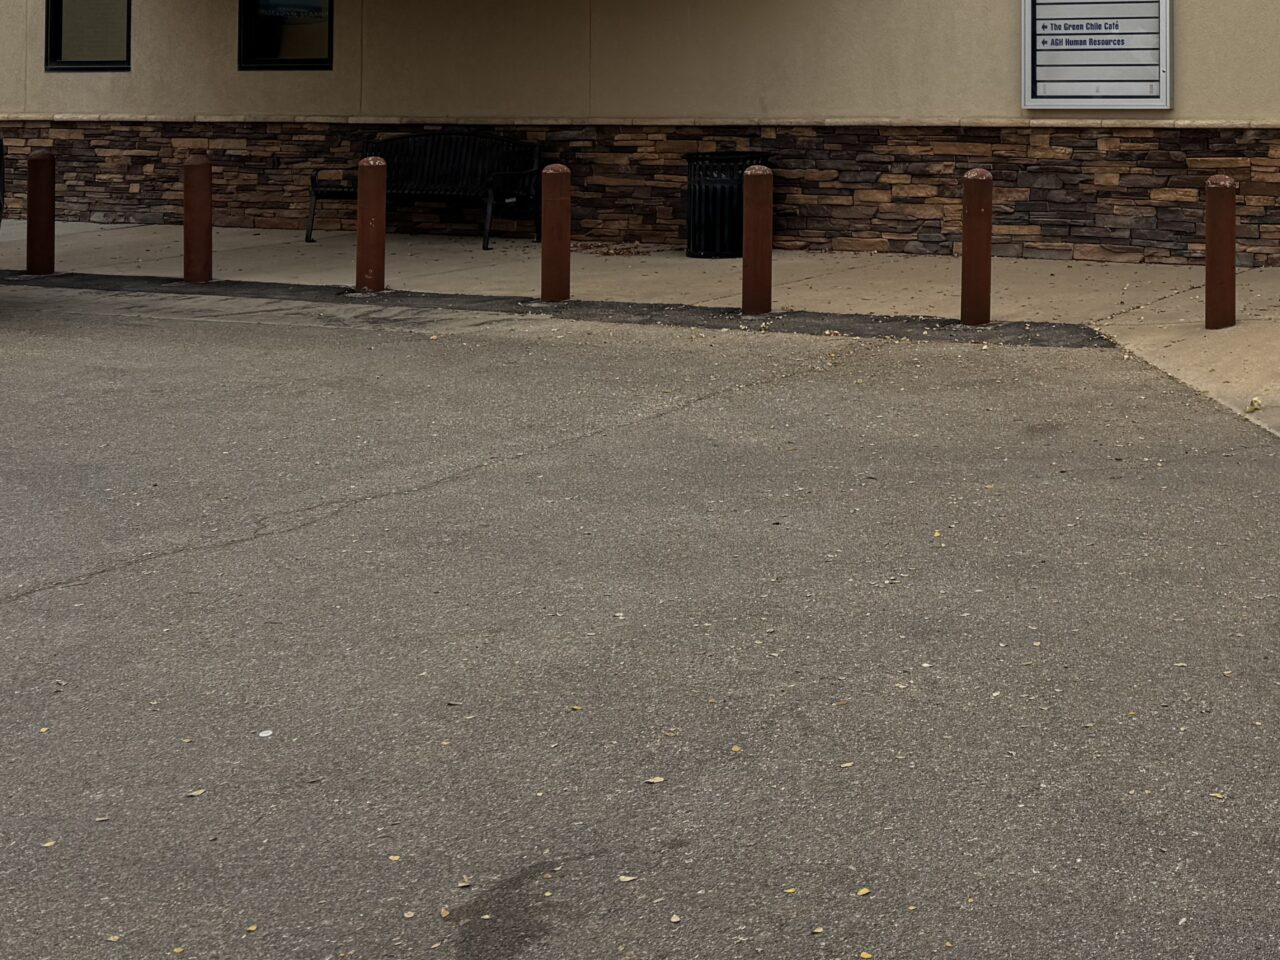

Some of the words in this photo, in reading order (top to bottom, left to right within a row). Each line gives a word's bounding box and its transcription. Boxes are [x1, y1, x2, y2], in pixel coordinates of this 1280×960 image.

[1050, 23, 1062, 31] The
[1064, 23, 1084, 31] Green
[1086, 22, 1102, 30] Chile
[1104, 20, 1119, 30] Café
[1051, 38, 1064, 47] AGH
[1065, 38, 1087, 46] Human
[1089, 38, 1125, 46] Resources
